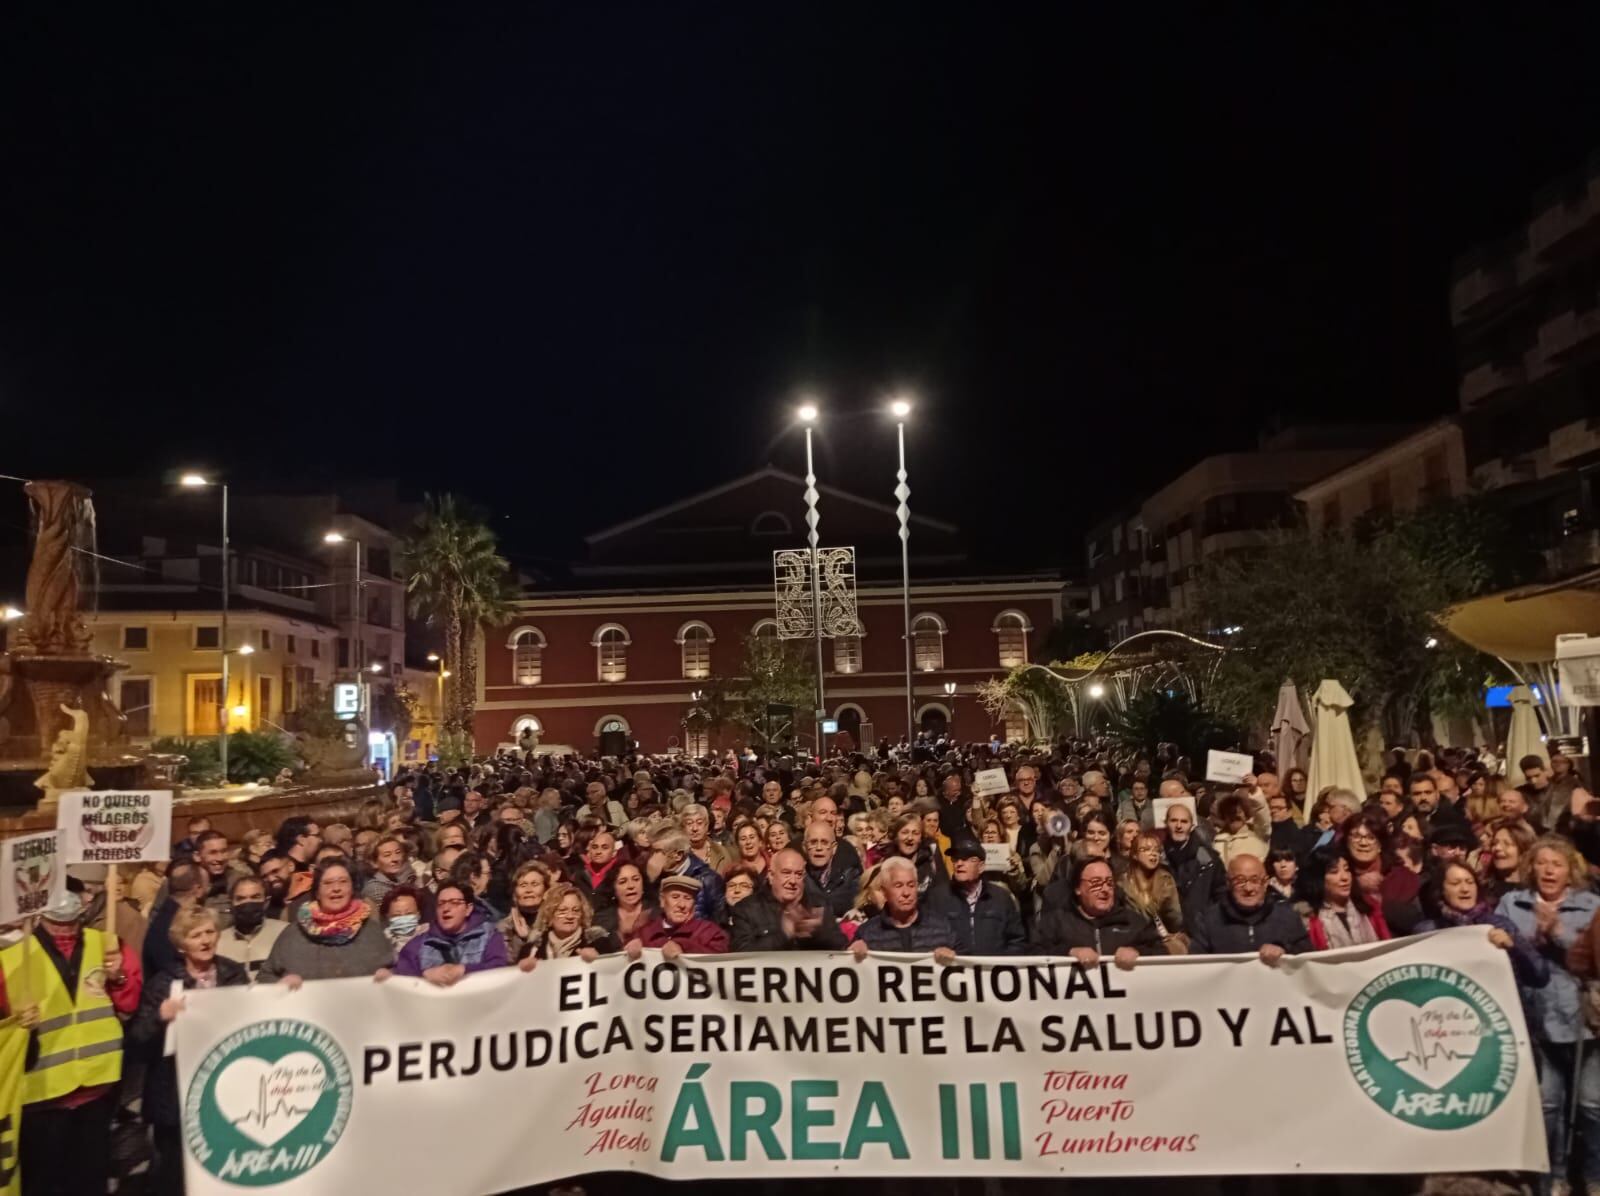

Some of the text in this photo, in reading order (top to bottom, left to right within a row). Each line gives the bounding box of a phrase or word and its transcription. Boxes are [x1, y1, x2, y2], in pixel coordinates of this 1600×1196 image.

[83, 795, 150, 809] NO QUIERO
[81, 812, 149, 826] MILAGROS
[560, 962, 1126, 1012] EL GOBIERNO REGIONAL
[364, 1005, 1334, 1086] PERJUDICA SERIAMENTE LA SALUD Y AL
[1345, 1010, 1382, 1098] PLATAFORMA
[1364, 966, 1419, 998] DEFENSA
[1421, 966, 1438, 980] DE
[1439, 967, 1460, 985] LA
[1457, 978, 1510, 1034] SANIDAD
[584, 1071, 660, 1098] Lorca
[660, 1063, 1022, 1161] ÁREA III
[1040, 1099, 1134, 1124] Puerto
[584, 1128, 651, 1156] Aledo
[1034, 1130, 1200, 1158] Lumbreras
